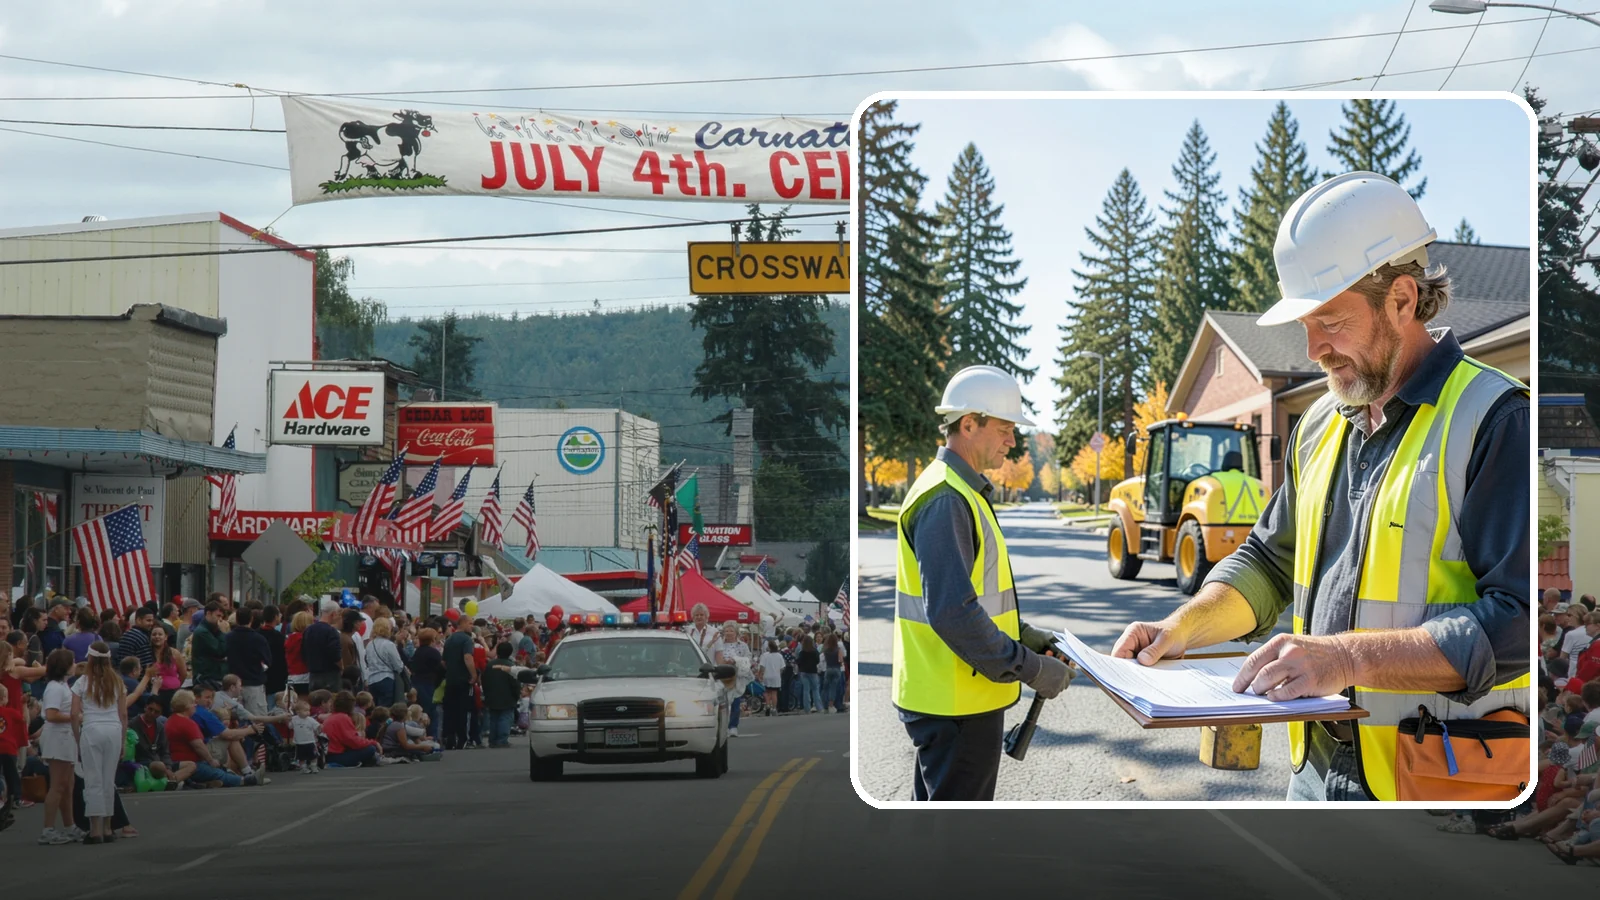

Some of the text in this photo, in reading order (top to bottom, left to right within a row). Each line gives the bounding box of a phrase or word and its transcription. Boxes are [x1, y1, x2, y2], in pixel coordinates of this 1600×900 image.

[481, 141, 605, 192] JULY
[632, 150, 746, 198] 4th.
[697, 254, 850, 280] CROSSWA
[283, 380, 373, 420] ACE
[406, 409, 485, 422] CEDAR LOG
[283, 421, 371, 437] Hardware
[416, 428, 477, 447] Coca-Cola
[354, 467, 386, 480] Simpl
[95, 485, 124, 495] Vincent
[126, 485, 136, 495] de
[137, 485, 155, 495] Paul
[212, 516, 331, 535] HARDARE
[688, 526, 741, 535] CRNATION
[699, 535, 730, 543] GLASS
